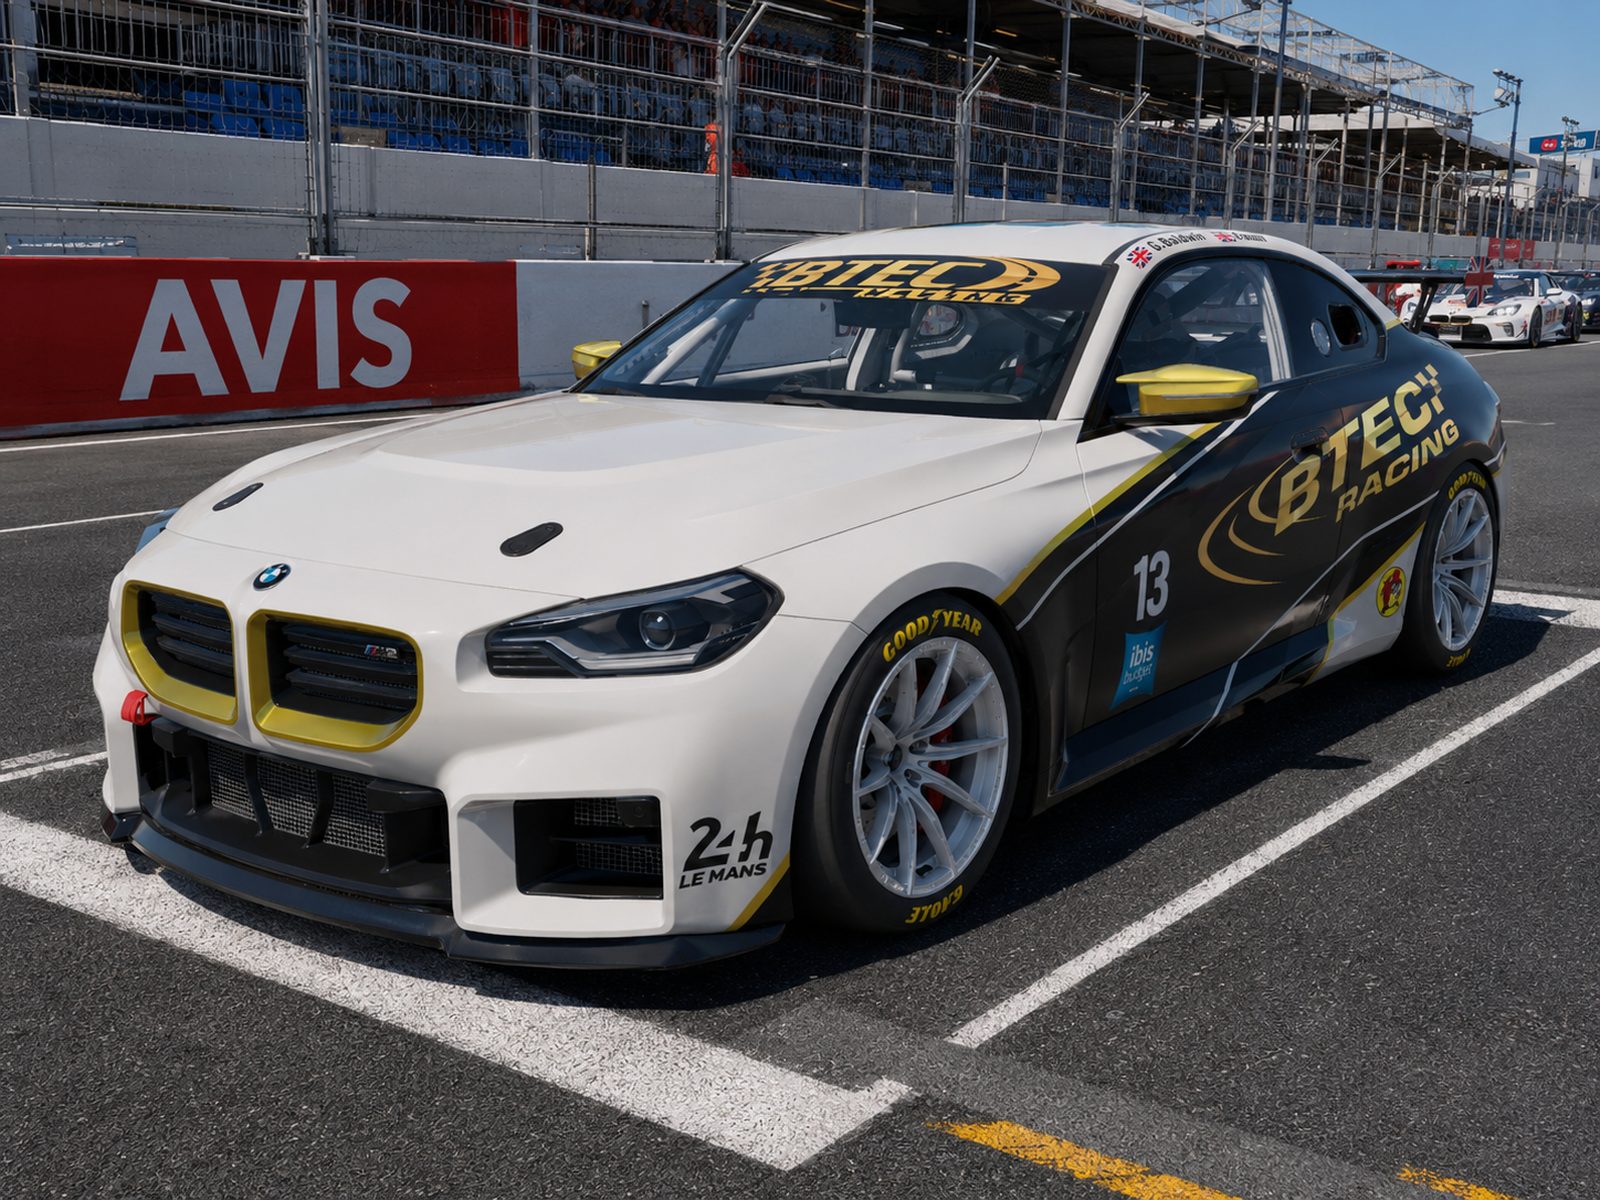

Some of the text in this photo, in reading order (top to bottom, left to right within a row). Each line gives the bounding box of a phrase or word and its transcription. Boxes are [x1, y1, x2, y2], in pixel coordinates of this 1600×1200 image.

[119, 277, 412, 401] AVIS
[1274, 381, 1432, 537] BTEC
[1335, 419, 1460, 523] RACING
[1133, 550, 1170, 622] 13
[1130, 640, 1154, 668] ibis
[679, 863, 767, 889] LE MANS
[683, 811, 773, 872] 24h
